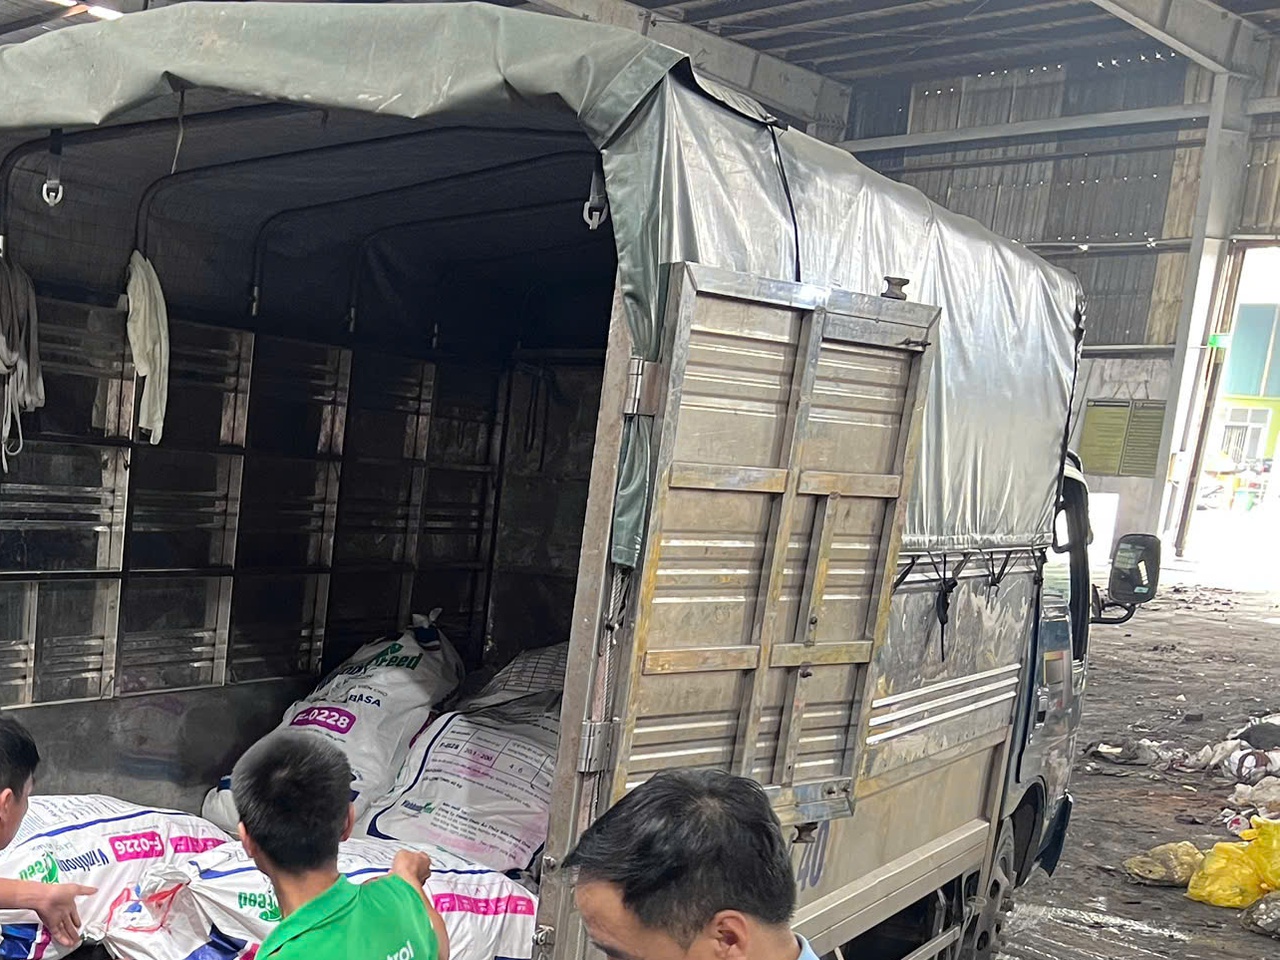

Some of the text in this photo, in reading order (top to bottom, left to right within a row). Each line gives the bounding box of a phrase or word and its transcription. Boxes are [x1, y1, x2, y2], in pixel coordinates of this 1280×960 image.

[348, 693, 381, 707] BASA
[294, 709, 350, 728] F-0228
[113, 835, 162, 856] F-0226
